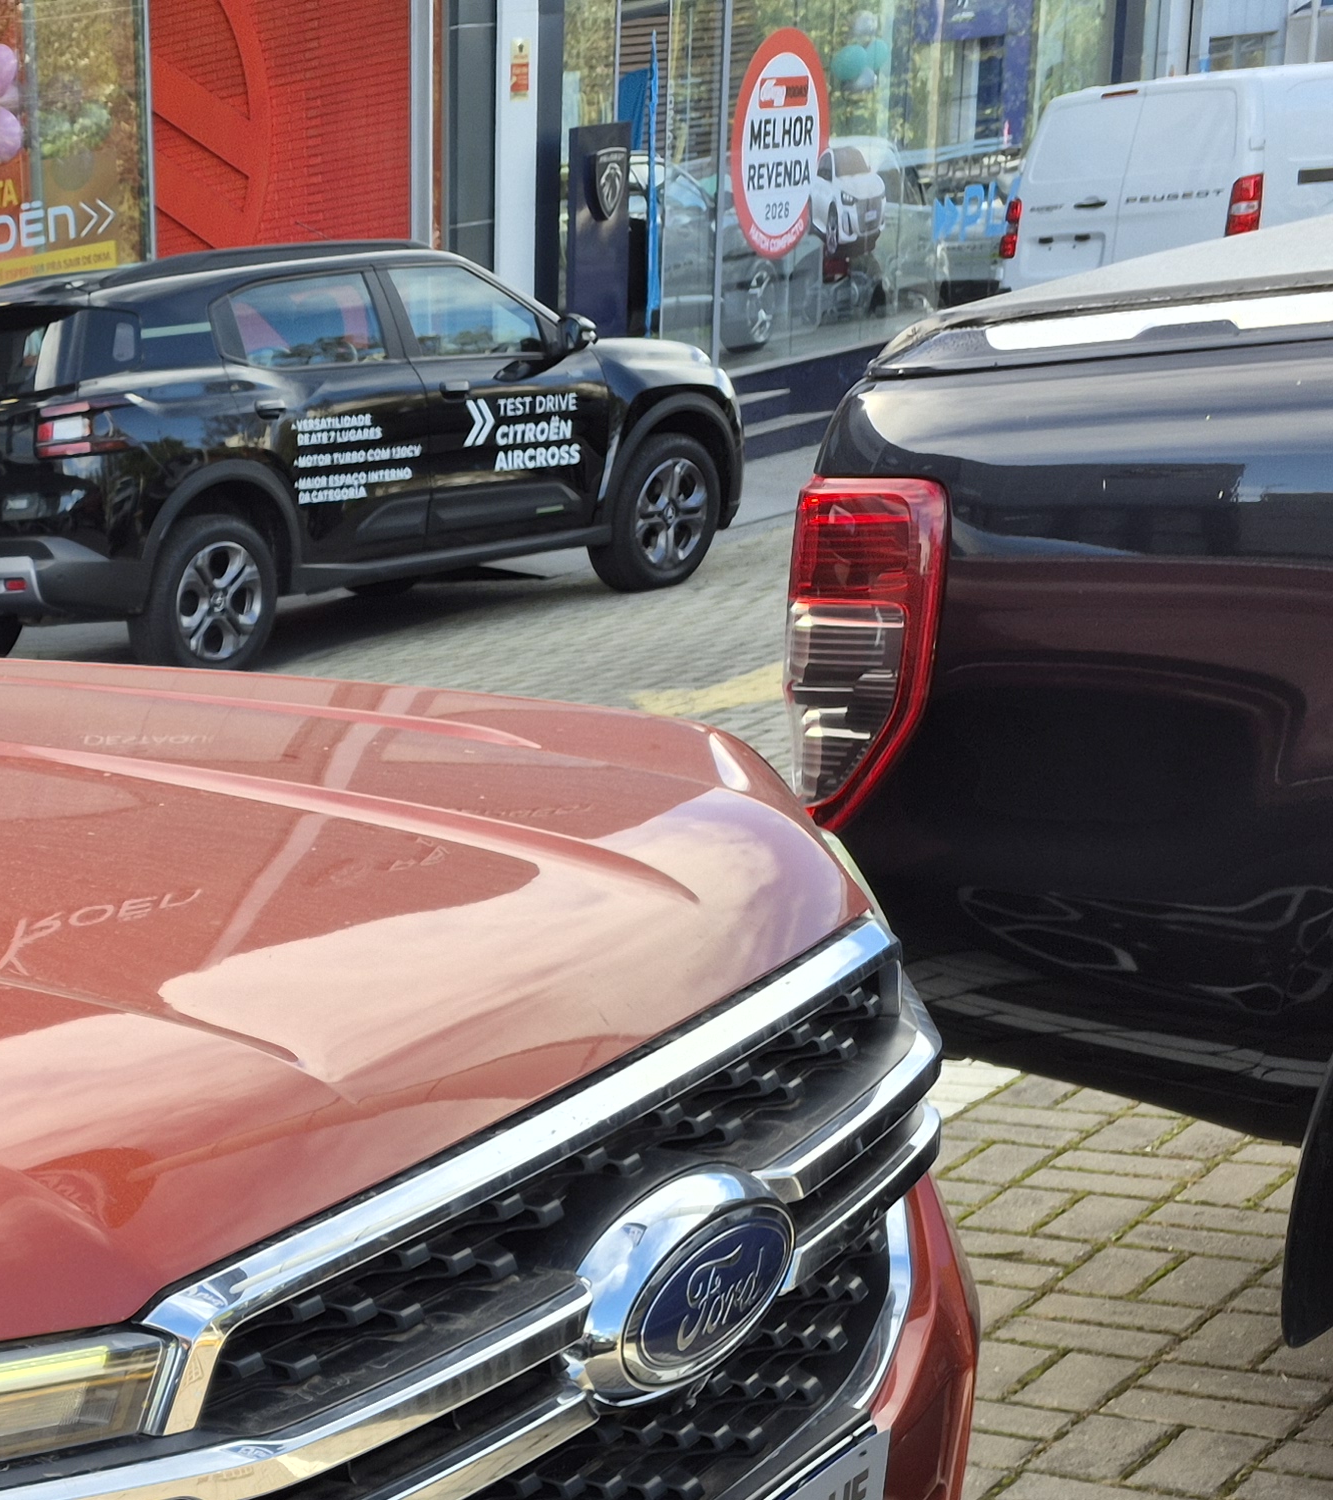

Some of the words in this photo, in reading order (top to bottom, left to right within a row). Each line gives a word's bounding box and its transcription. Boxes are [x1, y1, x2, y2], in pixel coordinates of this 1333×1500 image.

[749, 115, 814, 151] MELHOR
[747, 159, 811, 191] REVENDA
[1125, 188, 1225, 205] PEUGEOT
[764, 201, 791, 221] 2026
[497, 397, 532, 416] TEST
[535, 392, 579, 414] DRIVE
[336, 426, 383, 443] LUGARES
[494, 416, 573, 446] CITROËN
[297, 453, 332, 468] MOTOR
[333, 449, 366, 465] TURBO
[366, 447, 391, 462] COM
[494, 443, 583, 472] AIRCROSS
[367, 466, 413, 483] INTERNO
[677, 1243, 765, 1351] Ford
